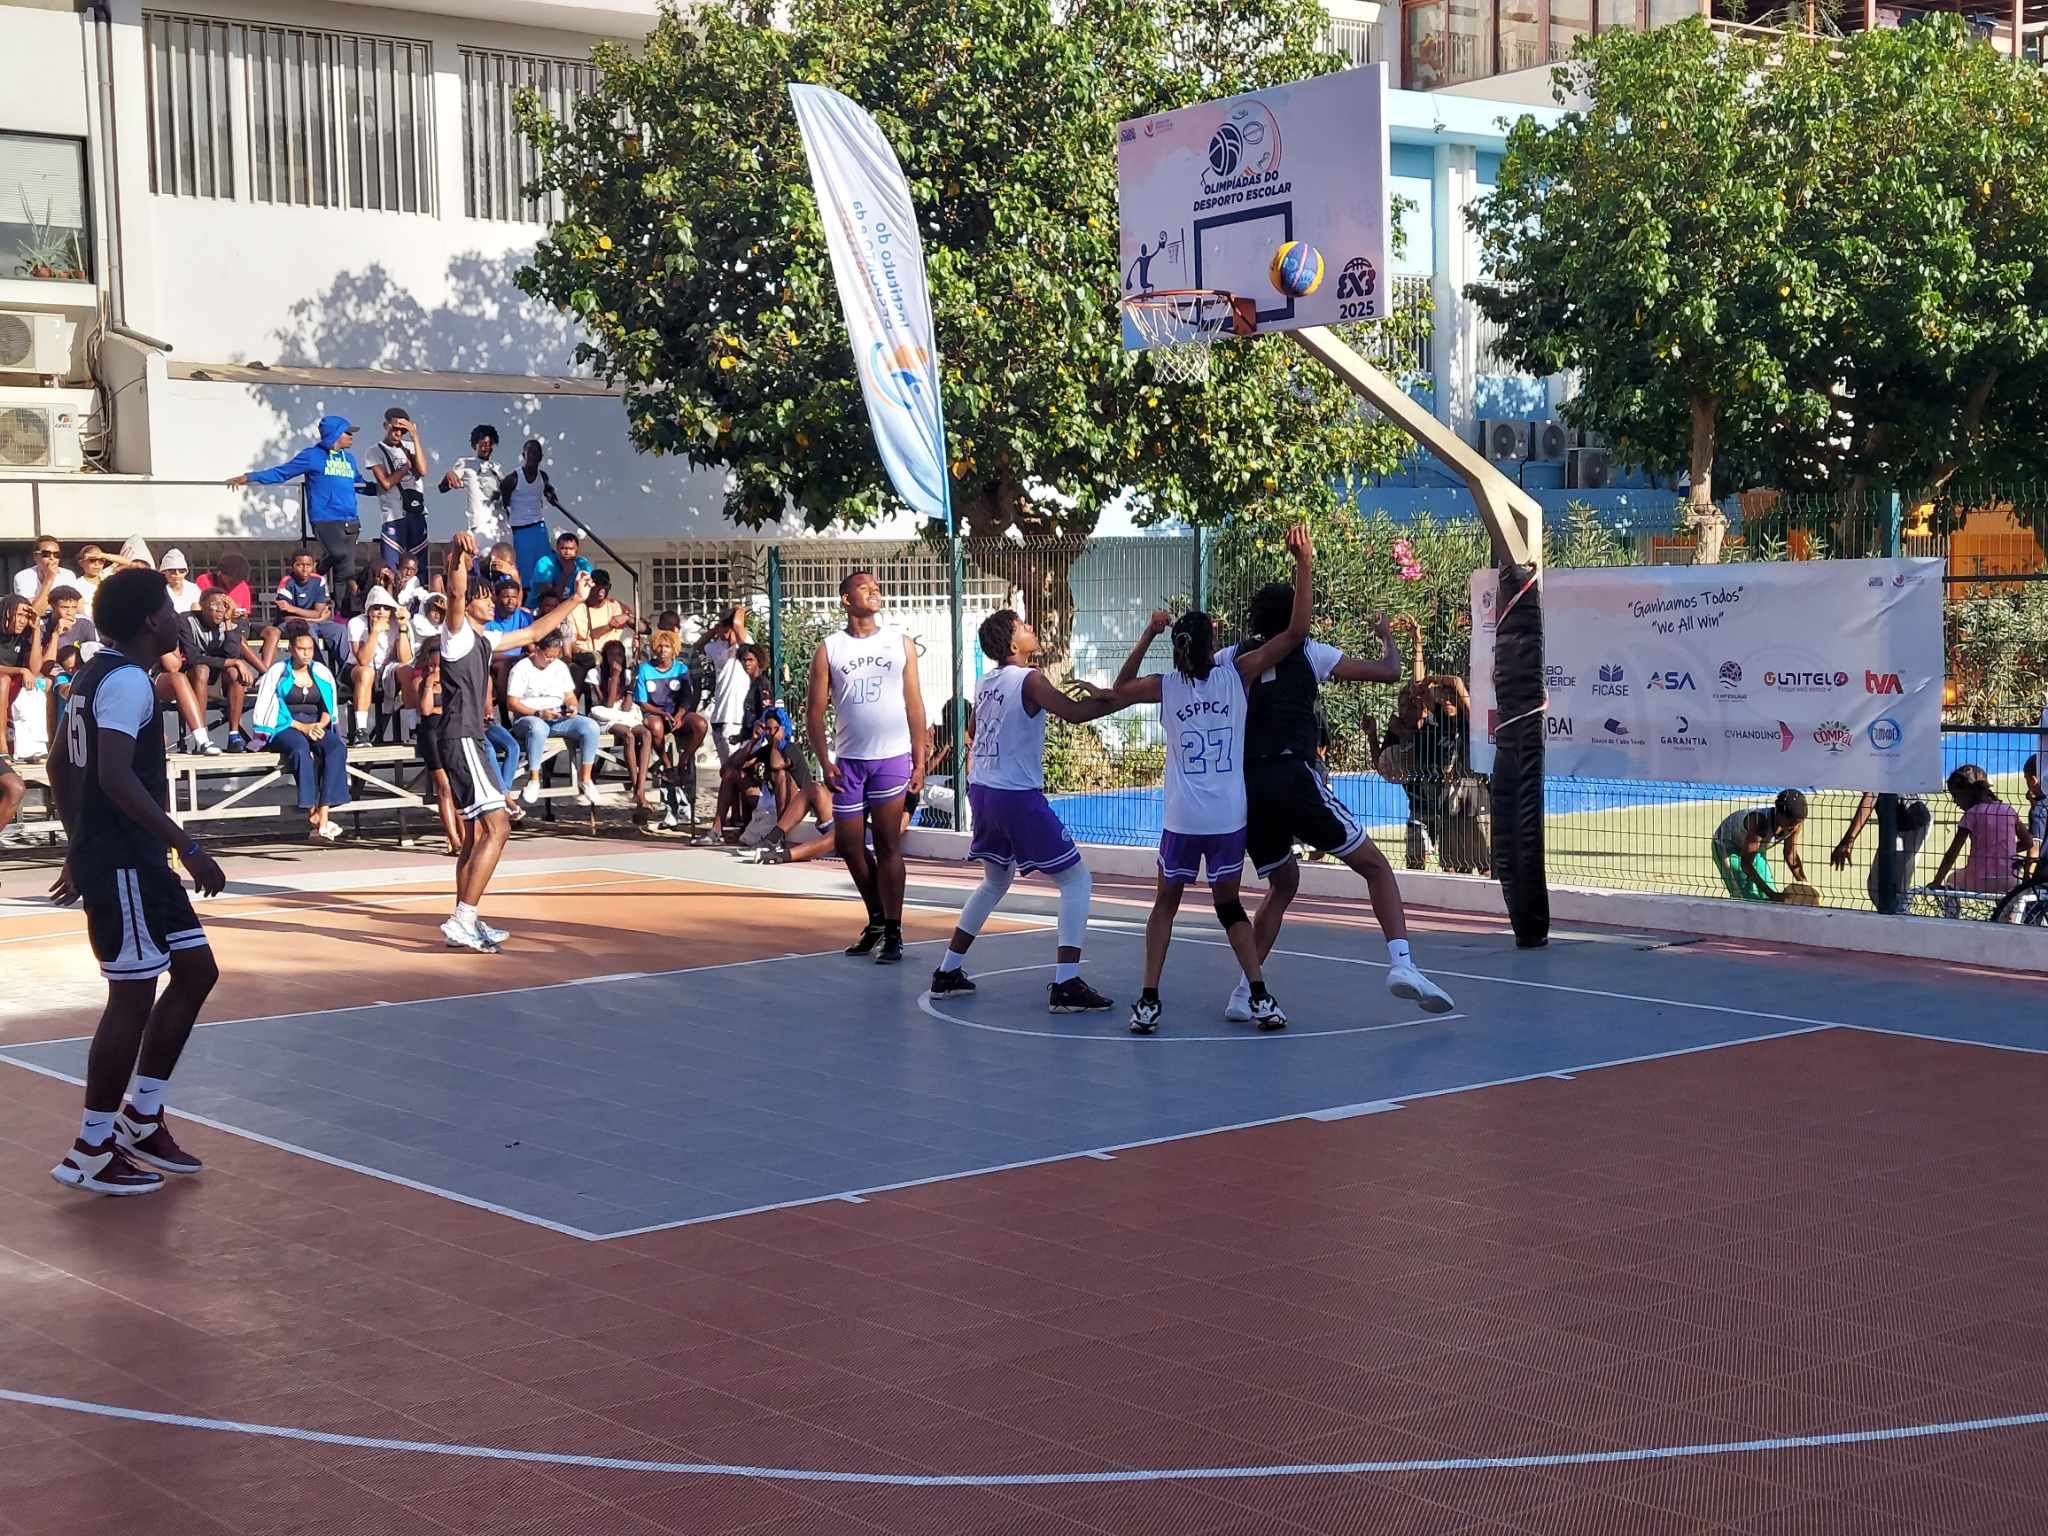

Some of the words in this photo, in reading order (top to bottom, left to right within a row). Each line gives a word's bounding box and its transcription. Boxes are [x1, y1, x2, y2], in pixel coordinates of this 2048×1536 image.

[1264, 170, 1279, 182] DO
[1193, 191, 1244, 212] DESPORTO
[1246, 182, 1292, 201] ESCOLAR
[1340, 301, 1375, 319] 2025
[1678, 616, 1694, 633] All
[841, 656, 892, 675] ESPPCA
[853, 676, 882, 704] 15
[1592, 684, 1630, 696] FICASE
[1646, 671, 1697, 690] ASA
[1176, 701, 1230, 722] ESPPCA
[65, 694, 88, 768] 15
[1547, 716, 1573, 735] BAI
[1180, 727, 1232, 774] 27
[1660, 736, 1708, 746] GARANTIA
